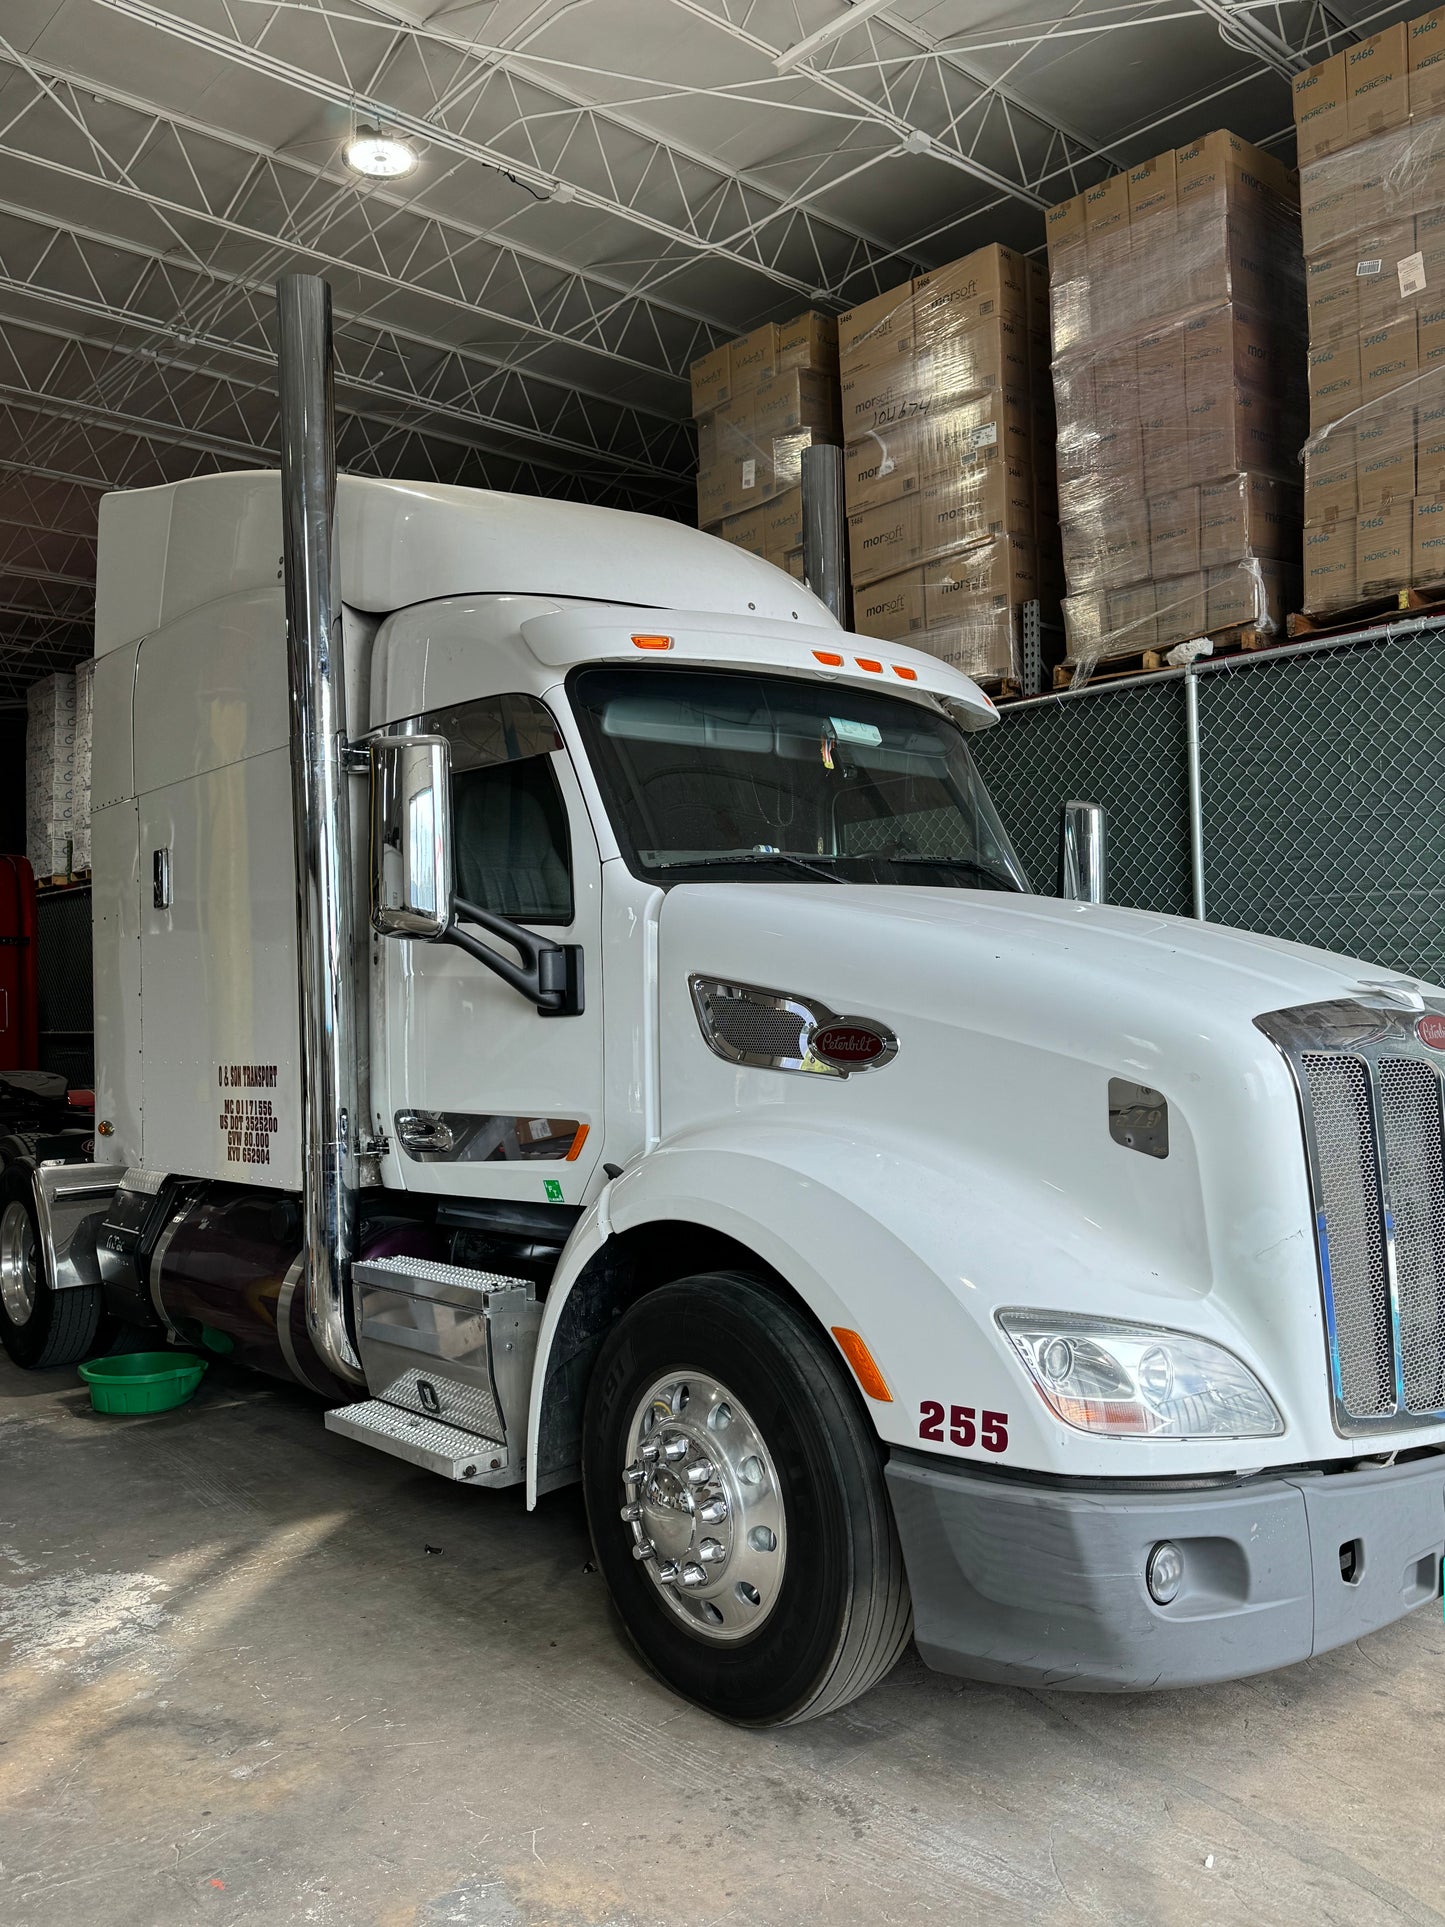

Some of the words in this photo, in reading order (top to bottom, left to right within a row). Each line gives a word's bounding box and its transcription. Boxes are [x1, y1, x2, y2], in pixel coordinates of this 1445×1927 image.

[1412, 19, 1438, 38] 3466
[1350, 47, 1374, 65] 3466
[1415, 49, 1445, 71] MORC
[1296, 77, 1318, 93] 3466
[1179, 150, 1200, 164] 3466
[1131, 169, 1150, 184] 3466
[1087, 188, 1106, 203] 3466
[1049, 210, 1067, 224] 3466
[917, 277, 931, 290] 3466
[840, 314, 853, 326] 3466
[1364, 332, 1388, 348] 3466
[1311, 351, 1334, 367] 3466
[855, 386, 894, 414] morsoft
[1418, 502, 1443, 516] 3466
[1360, 517, 1385, 530] 3466
[863, 524, 903, 549] morsoft
[1307, 532, 1330, 546] 3466
[1421, 537, 1445, 549] MORC
[866, 594, 905, 618] morsoft
[821, 1032, 876, 1051] Peterbilt
[230, 1065, 241, 1087] SON
[243, 1065, 278, 1087] TRANSPORT
[224, 1099, 234, 1115] MC
[236, 1099, 272, 1116] 01171556
[220, 1115, 228, 1129] US
[230, 1115, 243, 1130] DOT
[245, 1116, 278, 1133] 3525200
[228, 1131, 242, 1146] GVW
[228, 1146, 240, 1162] KYU
[242, 1147, 270, 1165] 652904
[919, 1400, 1009, 1453] 255
